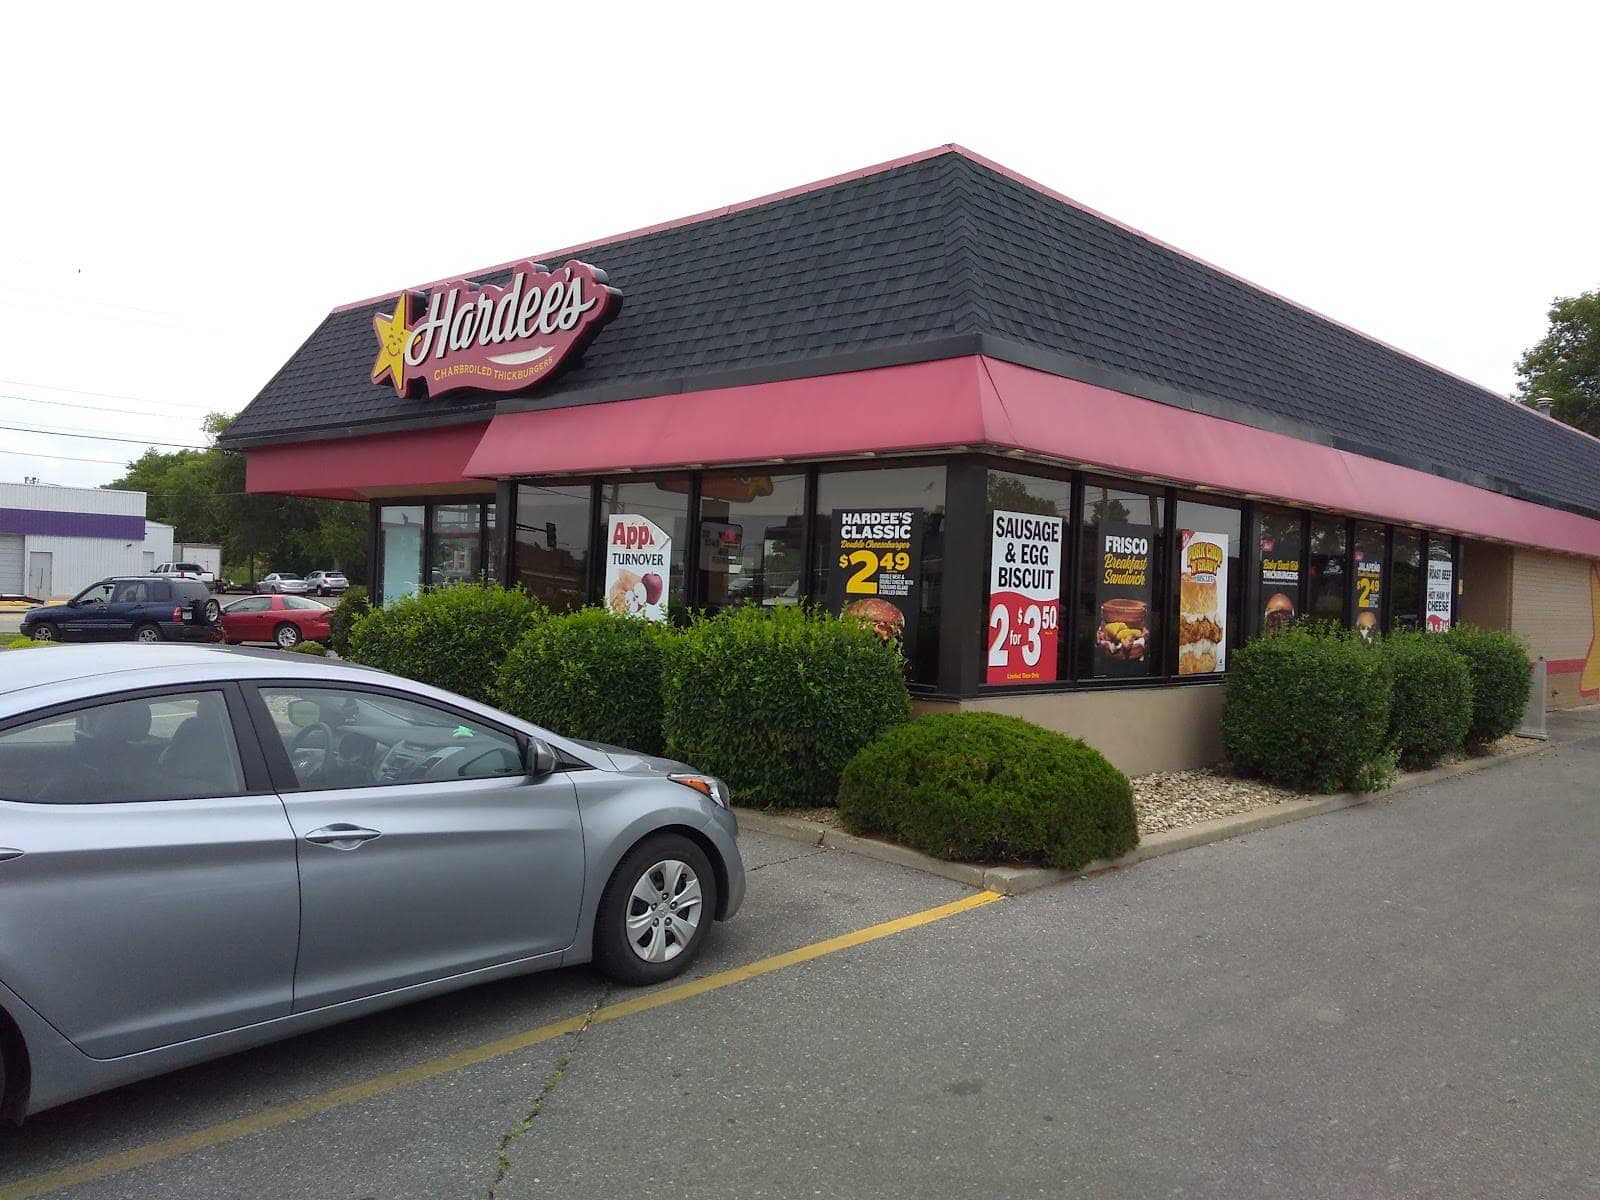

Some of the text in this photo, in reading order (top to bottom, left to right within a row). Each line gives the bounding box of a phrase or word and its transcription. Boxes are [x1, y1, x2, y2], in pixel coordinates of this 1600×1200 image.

[405, 267, 596, 366] Hardee's
[433, 356, 553, 381] CHARBROILED THICKBURGERS
[842, 512, 912, 525] HARDEE'S
[841, 525, 911, 539] CLASSIC
[995, 516, 1060, 543] SAUSAGE
[841, 540, 911, 551] Double Cheeseburger
[1005, 542, 1048, 566] & EGG
[1105, 535, 1148, 555] FRISCO
[612, 552, 664, 566] TURNOVER
[1104, 553, 1148, 574] Breakfast
[998, 566, 1054, 590] BISCUIT
[1103, 569, 1146, 586] Sandwich
[1428, 600, 1449, 611] CHEESE
[988, 603, 1010, 667] 2
[1010, 630, 1022, 645] for
